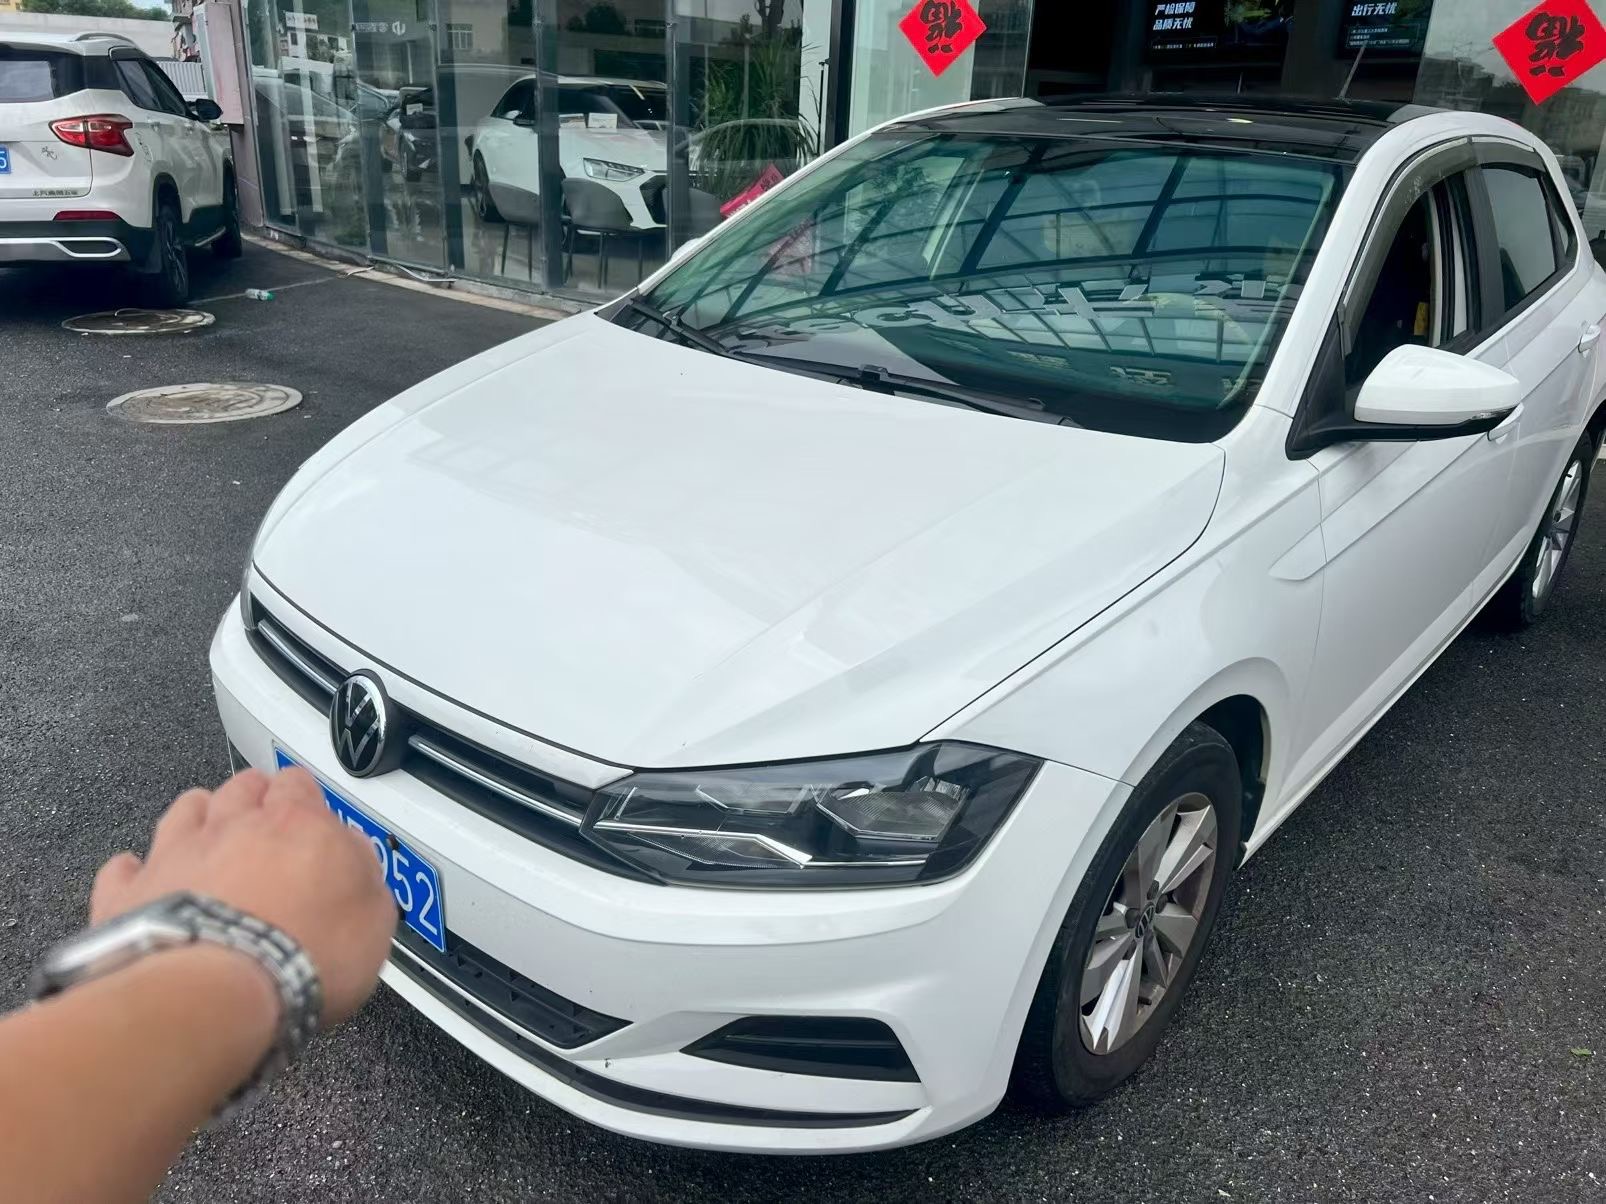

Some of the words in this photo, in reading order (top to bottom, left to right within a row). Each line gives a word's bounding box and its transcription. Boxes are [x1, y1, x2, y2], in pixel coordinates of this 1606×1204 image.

[1155, 2, 1196, 15] 严检保障
[1351, 2, 1397, 16] 出行无忧
[1152, 17, 1194, 31] 品质无忧
